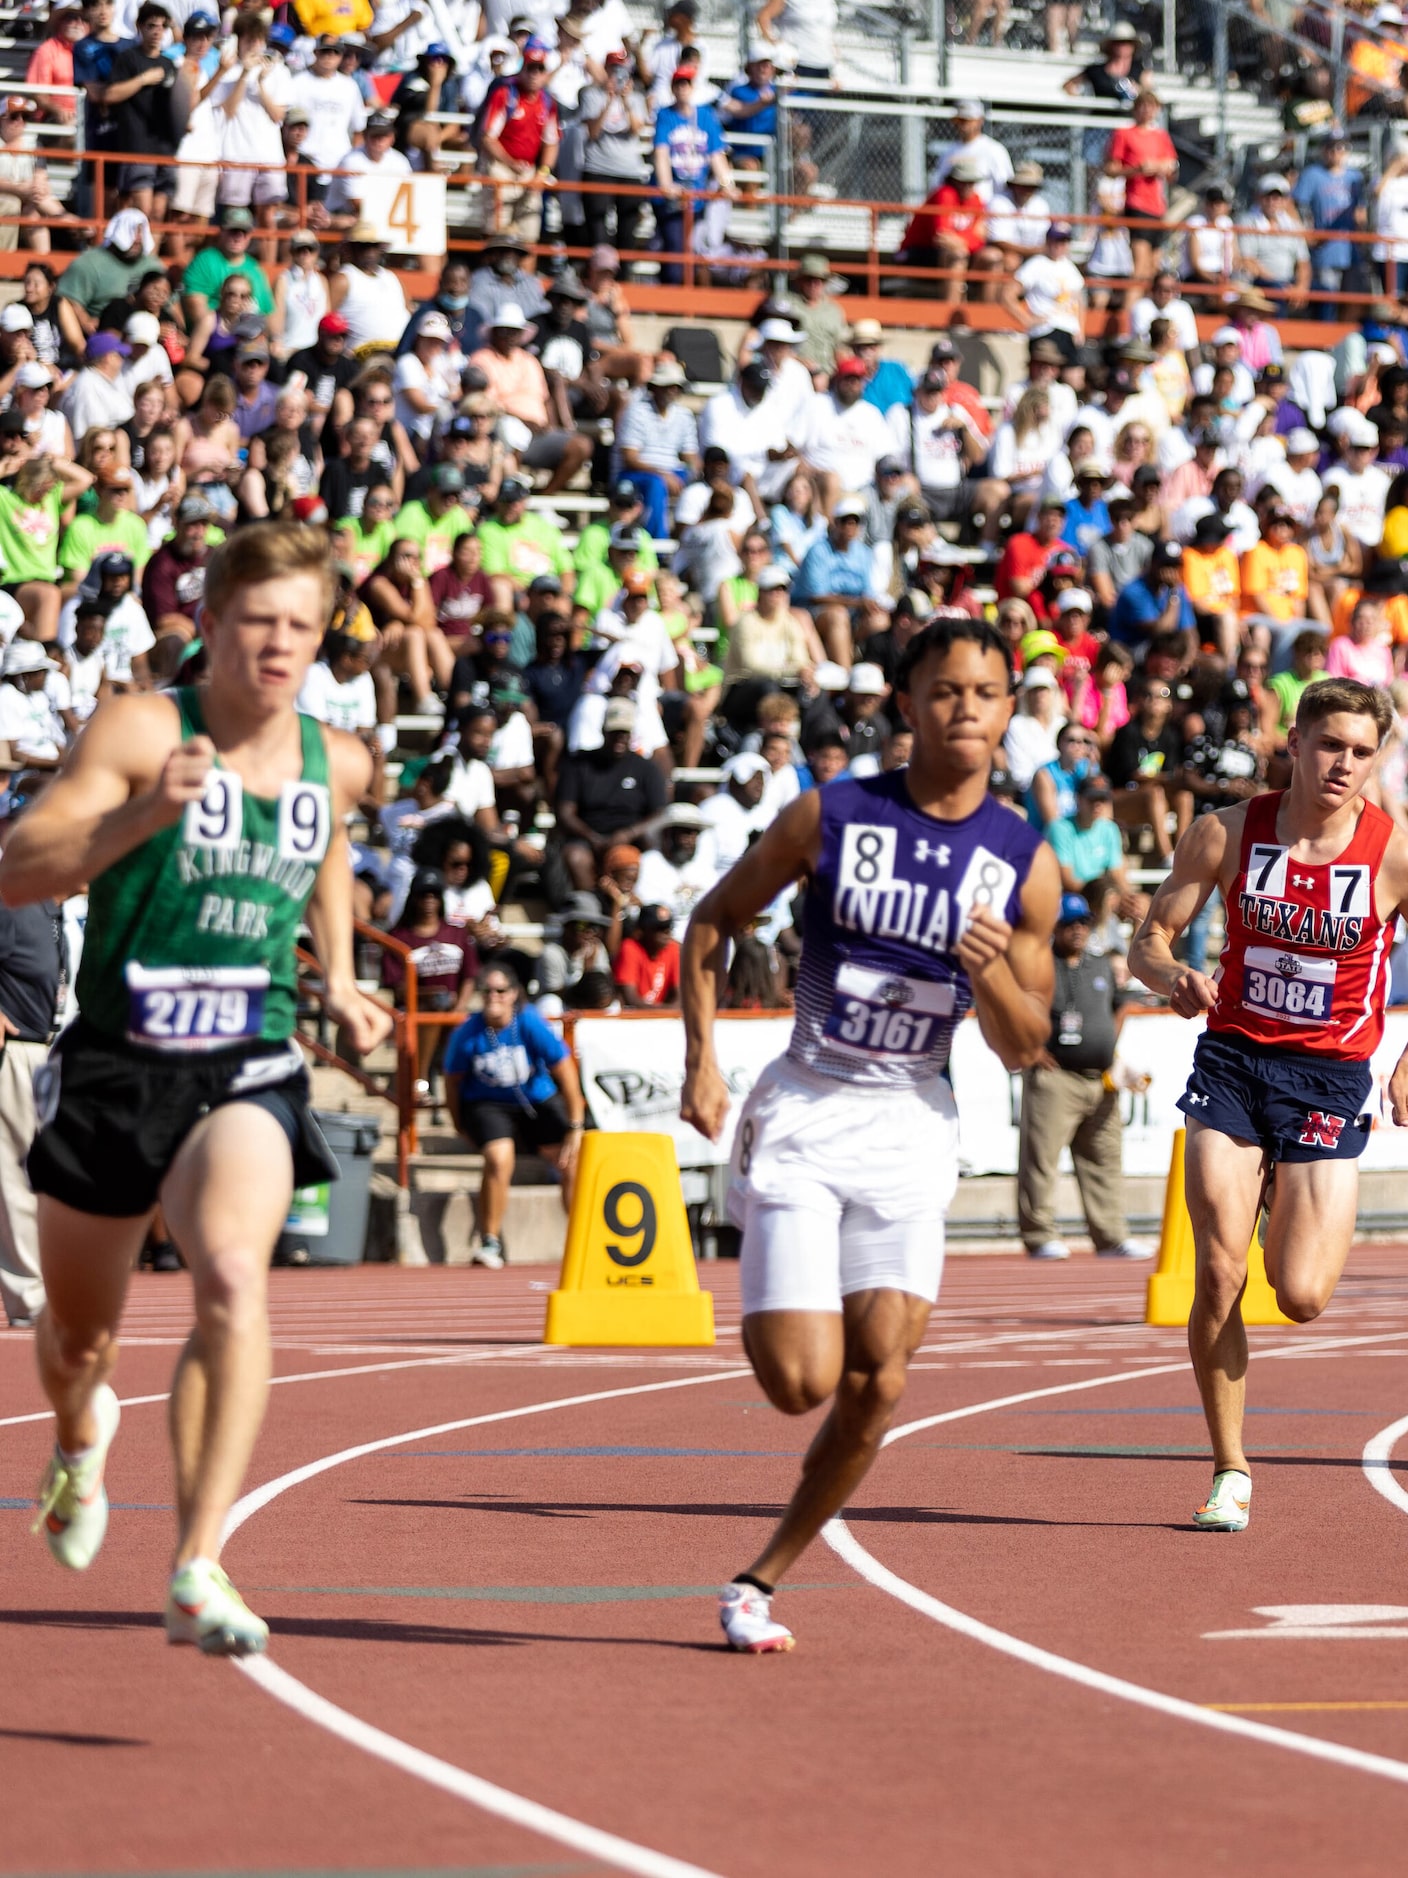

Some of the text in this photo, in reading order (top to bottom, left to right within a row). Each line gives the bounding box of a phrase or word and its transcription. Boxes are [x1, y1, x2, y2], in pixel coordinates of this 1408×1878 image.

[387, 182, 420, 246] 4
[199, 779, 320, 852] 9 9
[176, 839, 316, 901] KINGWOOD
[853, 829, 1003, 907] 8 8
[1253, 847, 1363, 914] 7 7
[197, 893, 275, 939] PARK
[1238, 891, 1365, 952] TEXANS
[1248, 971, 1325, 1017] 3084
[1274, 961, 1303, 974] STATE
[143, 989, 249, 1037] 2779
[838, 1000, 933, 1054] 3161
[739, 1117, 755, 1177] 8
[1299, 1110, 1347, 1149] N
[603, 1181, 657, 1267] 9
